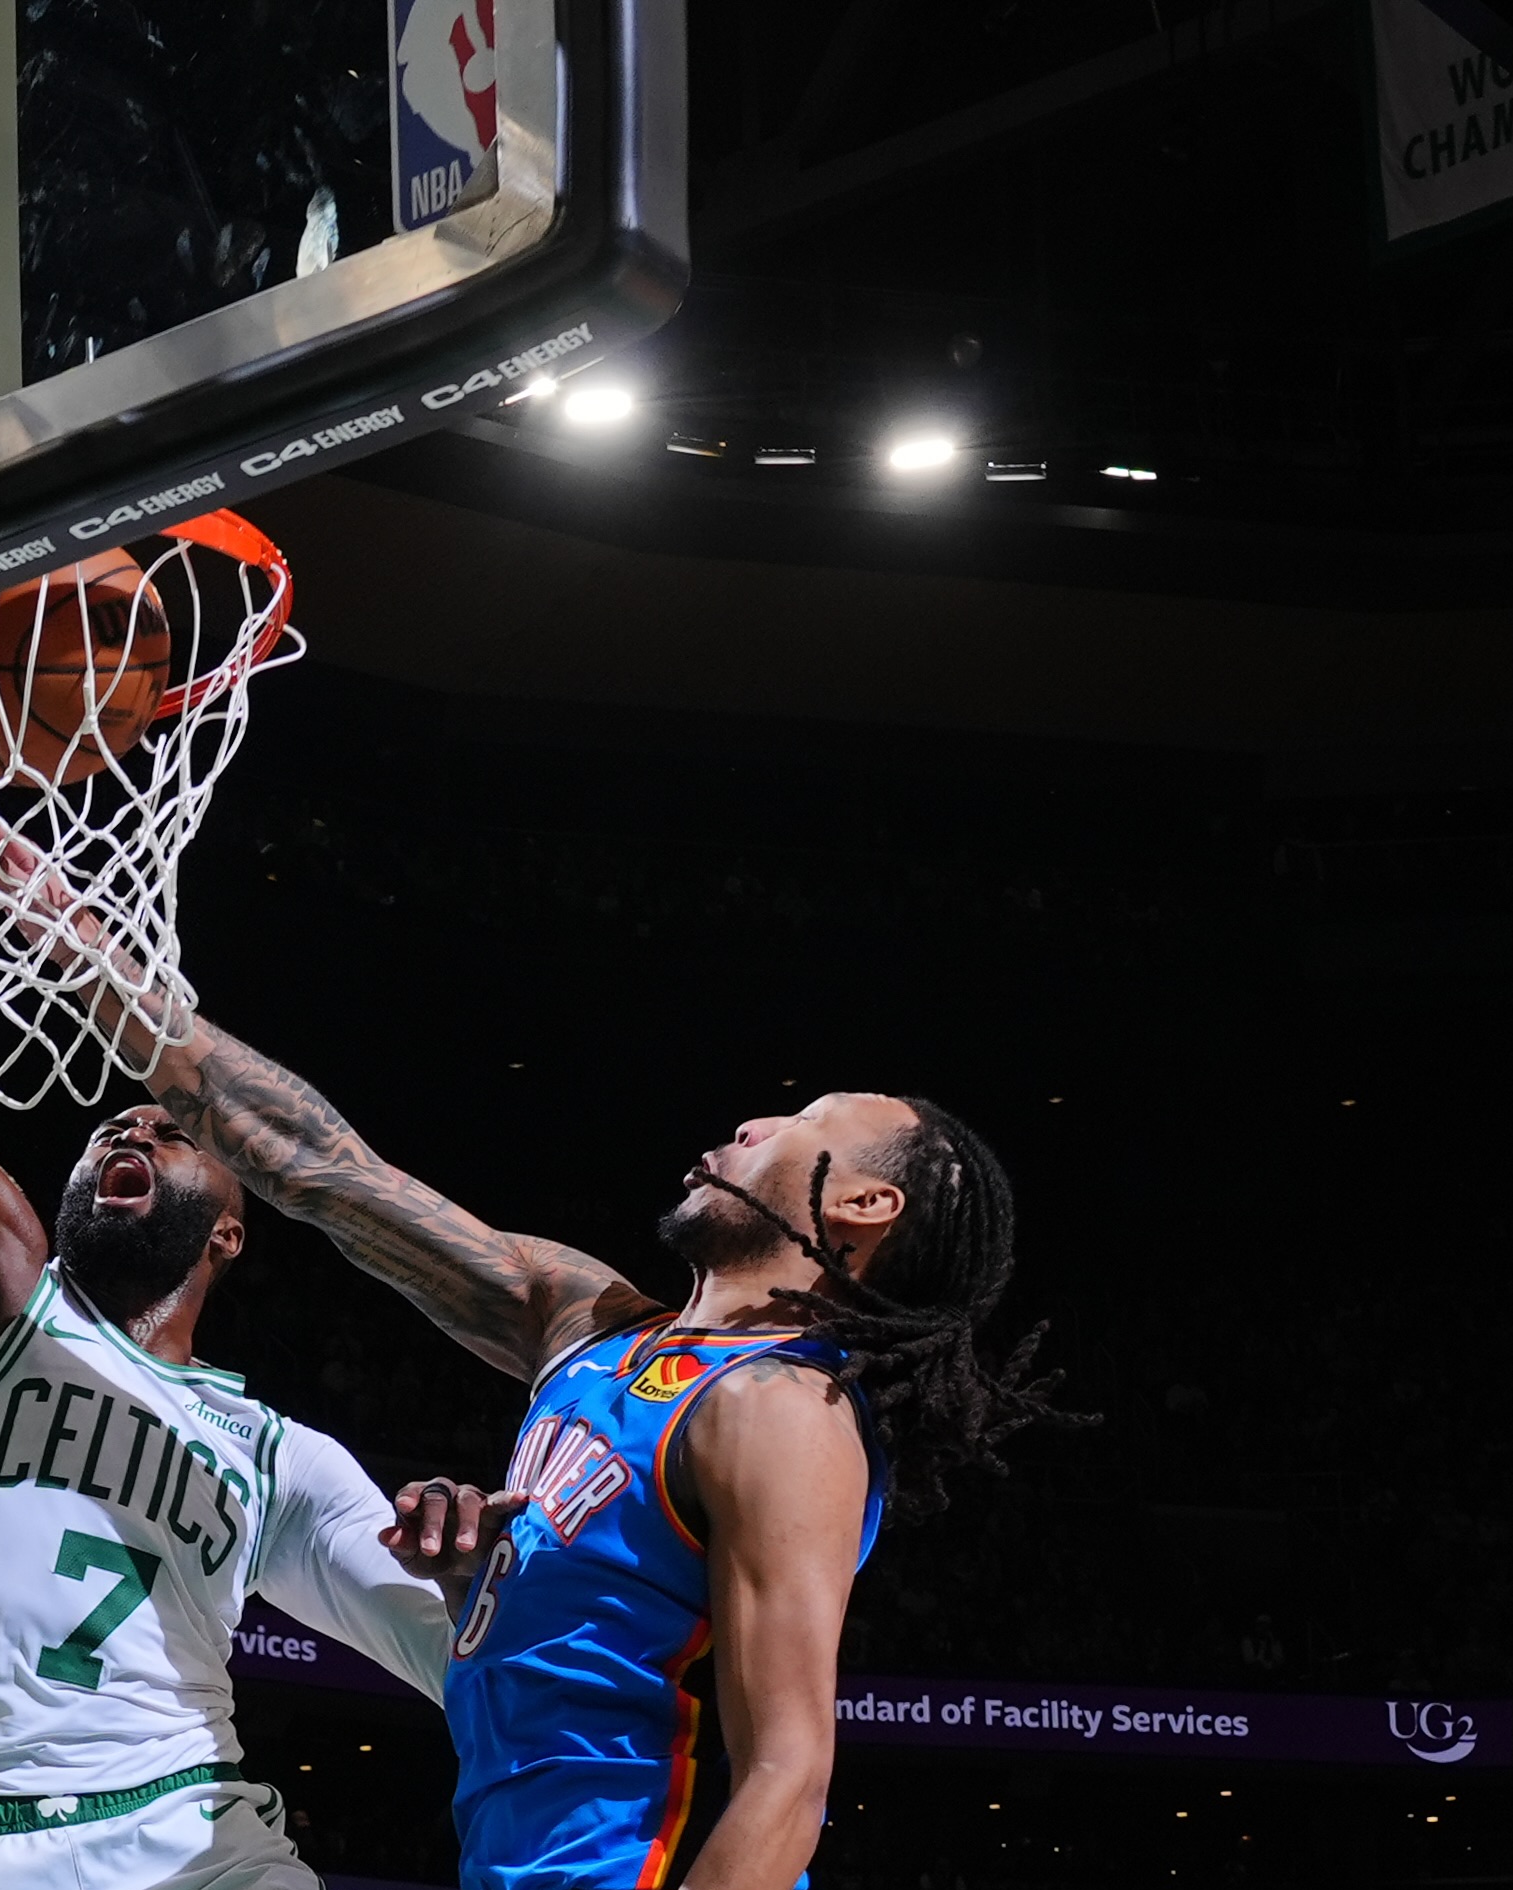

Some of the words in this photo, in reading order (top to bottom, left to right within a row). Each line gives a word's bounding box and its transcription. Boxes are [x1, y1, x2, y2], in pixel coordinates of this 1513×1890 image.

[411, 159, 463, 221] NBA
[498, 322, 594, 380] ENERGY
[313, 405, 405, 449] ENERGY
[138, 472, 226, 515] ENERGY
[185, 1400, 252, 1440] Amica
[36, 1529, 162, 1690] 7
[454, 1534, 514, 1660] 6
[233, 1625, 318, 1663] vices
[836, 1692, 930, 1723] ndard
[941, 1696, 975, 1725] of
[985, 1699, 1102, 1738] Facility
[1112, 1704, 1249, 1737] Services
[1385, 1701, 1478, 1741] UG2
